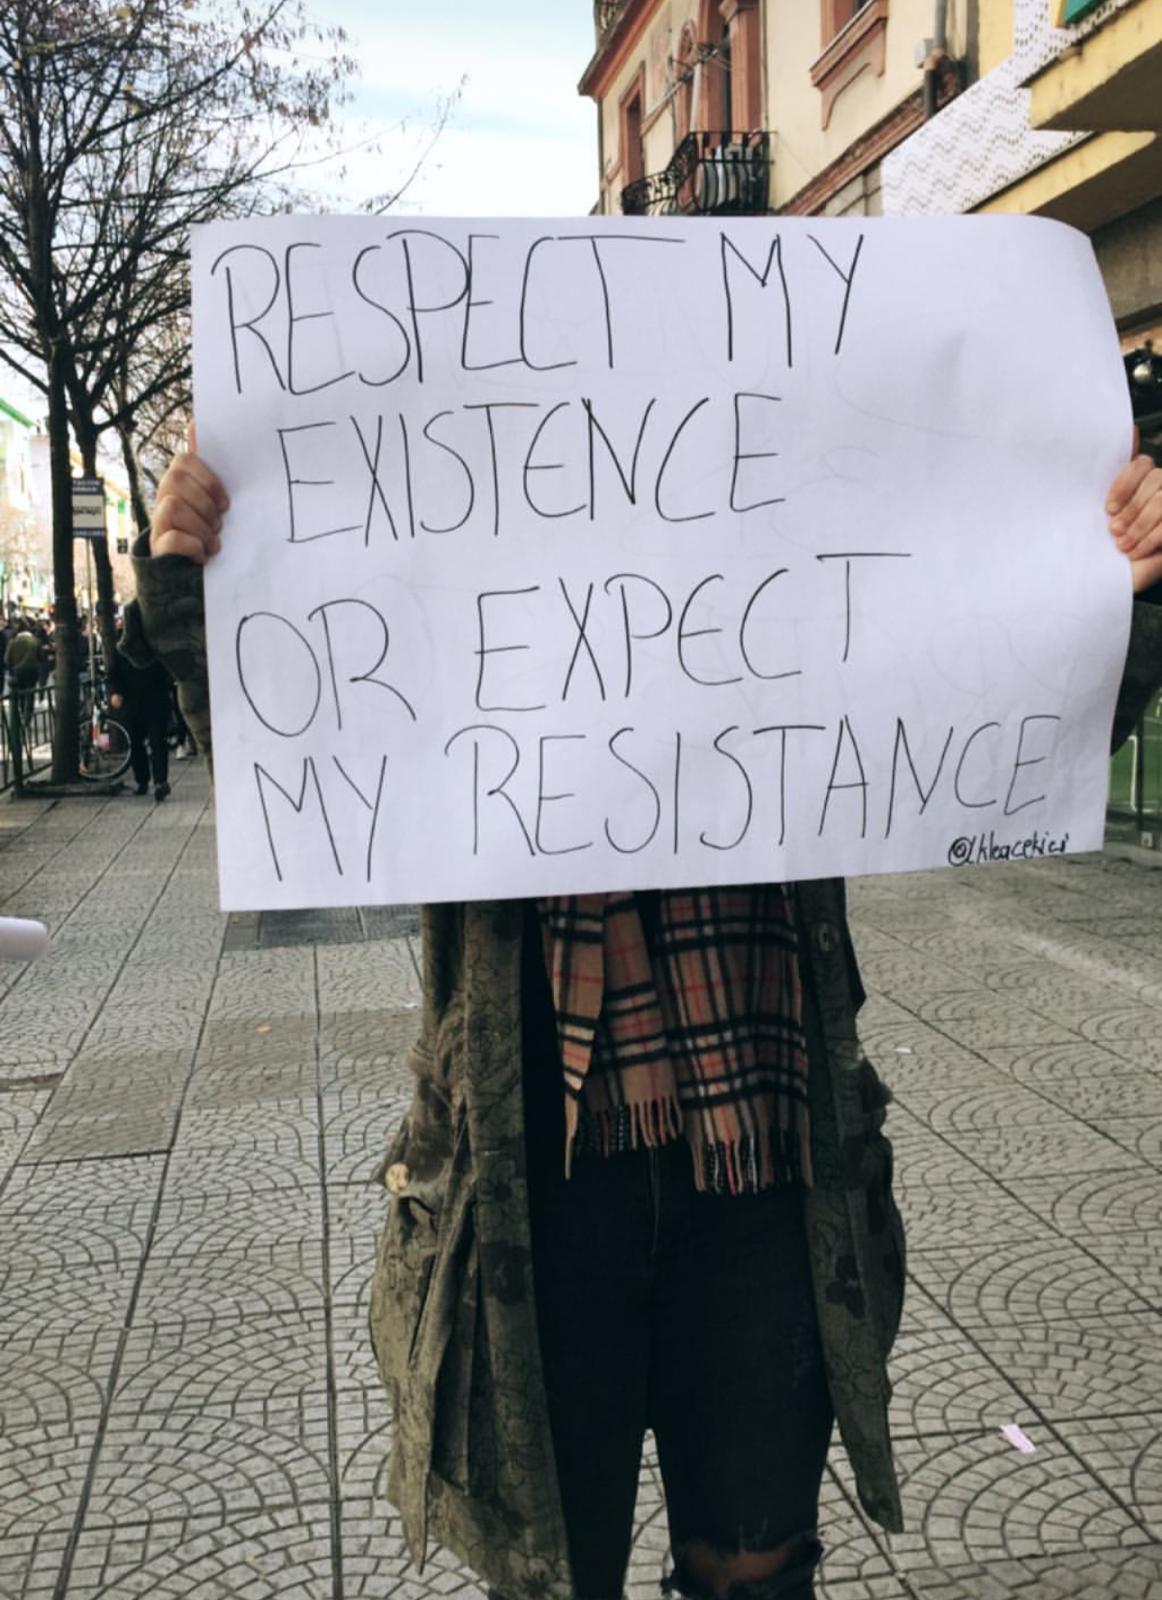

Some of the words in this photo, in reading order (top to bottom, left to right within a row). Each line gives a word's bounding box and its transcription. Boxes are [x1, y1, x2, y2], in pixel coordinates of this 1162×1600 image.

[211, 229, 685, 396] RESPECT
[720, 232, 864, 369] MY
[277, 392, 785, 547] EXISTENCE
[236, 599, 416, 737] OR
[474, 553, 911, 712] EXPECT
[254, 755, 387, 882] MY
[444, 715, 1061, 856] RESISTANCE
